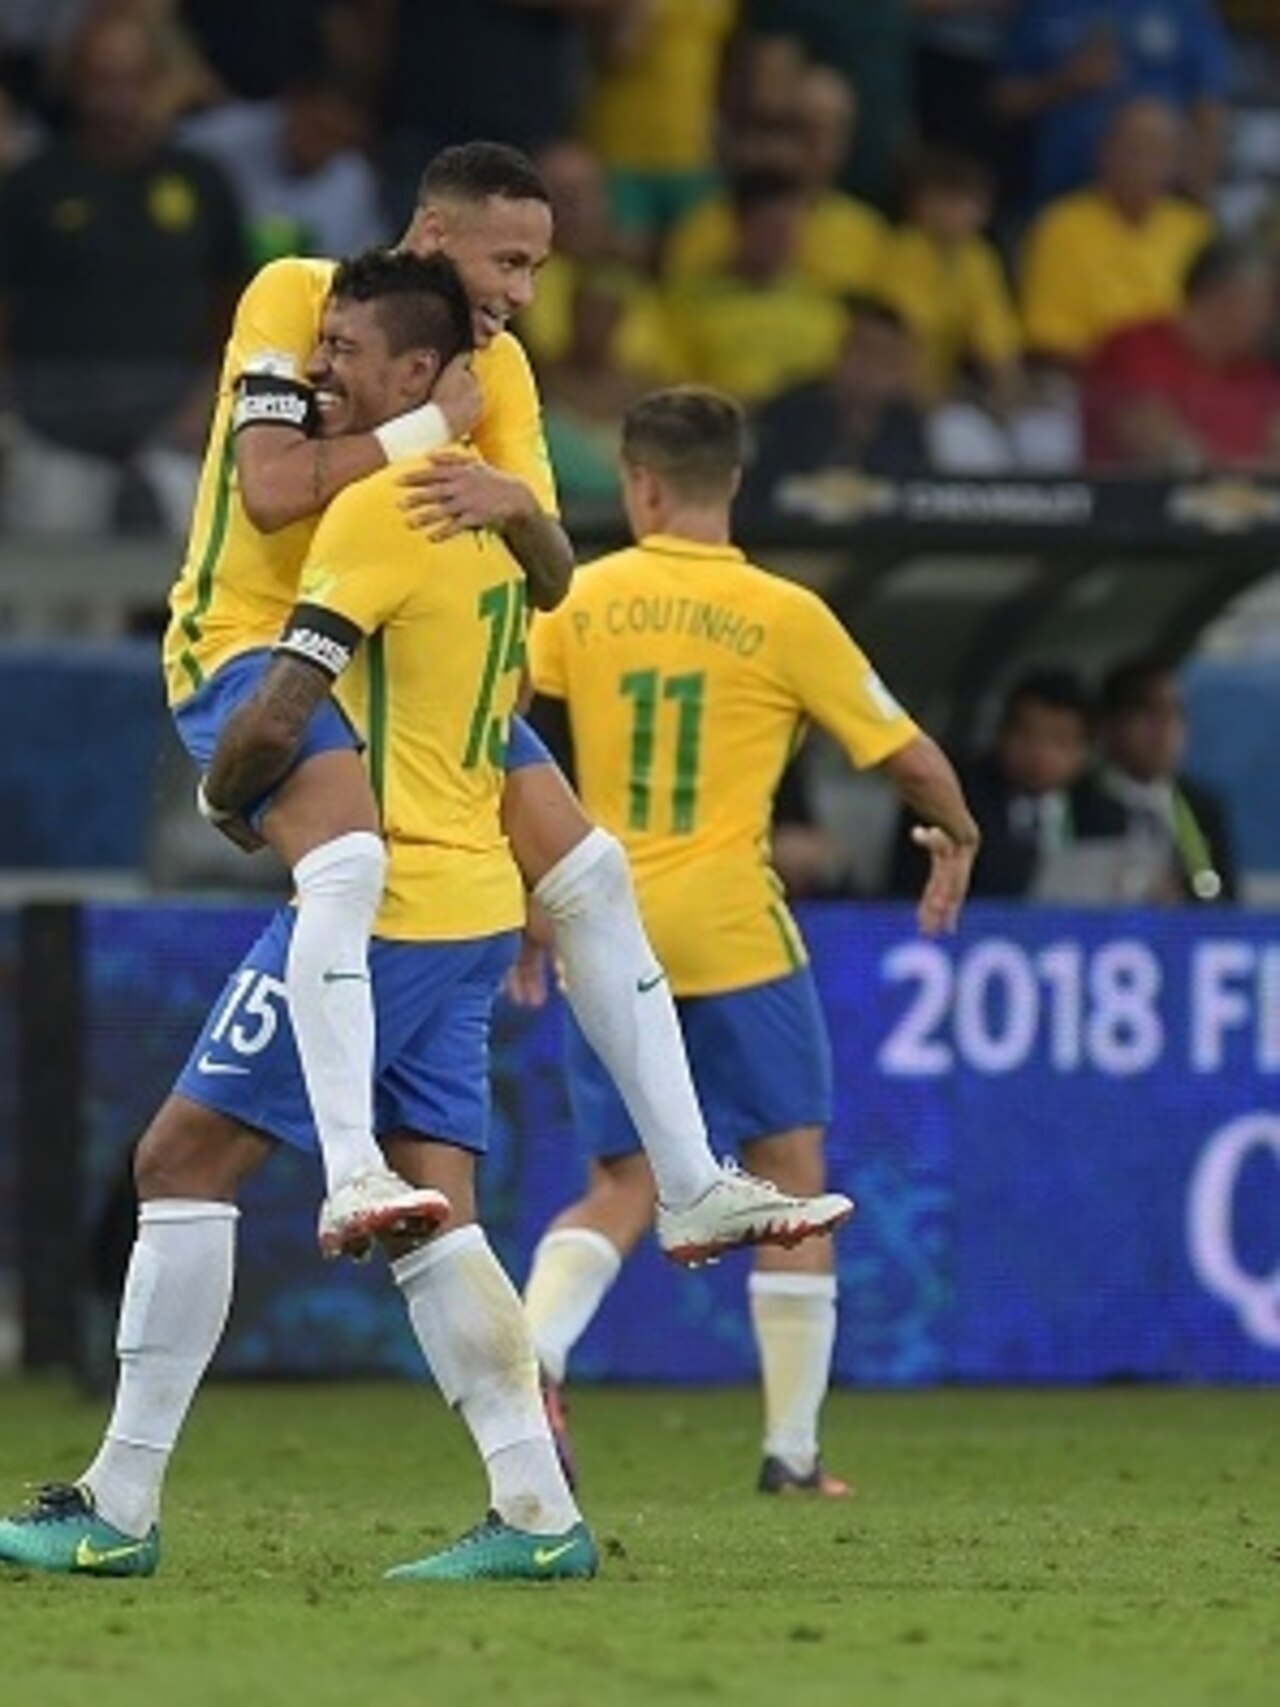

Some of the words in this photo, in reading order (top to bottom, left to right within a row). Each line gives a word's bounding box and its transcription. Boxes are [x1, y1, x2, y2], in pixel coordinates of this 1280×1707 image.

[607, 597, 765, 657] COUTINHO
[619, 667, 706, 836] 11
[210, 968, 287, 1054] 15
[877, 937, 1165, 1076] 2018
